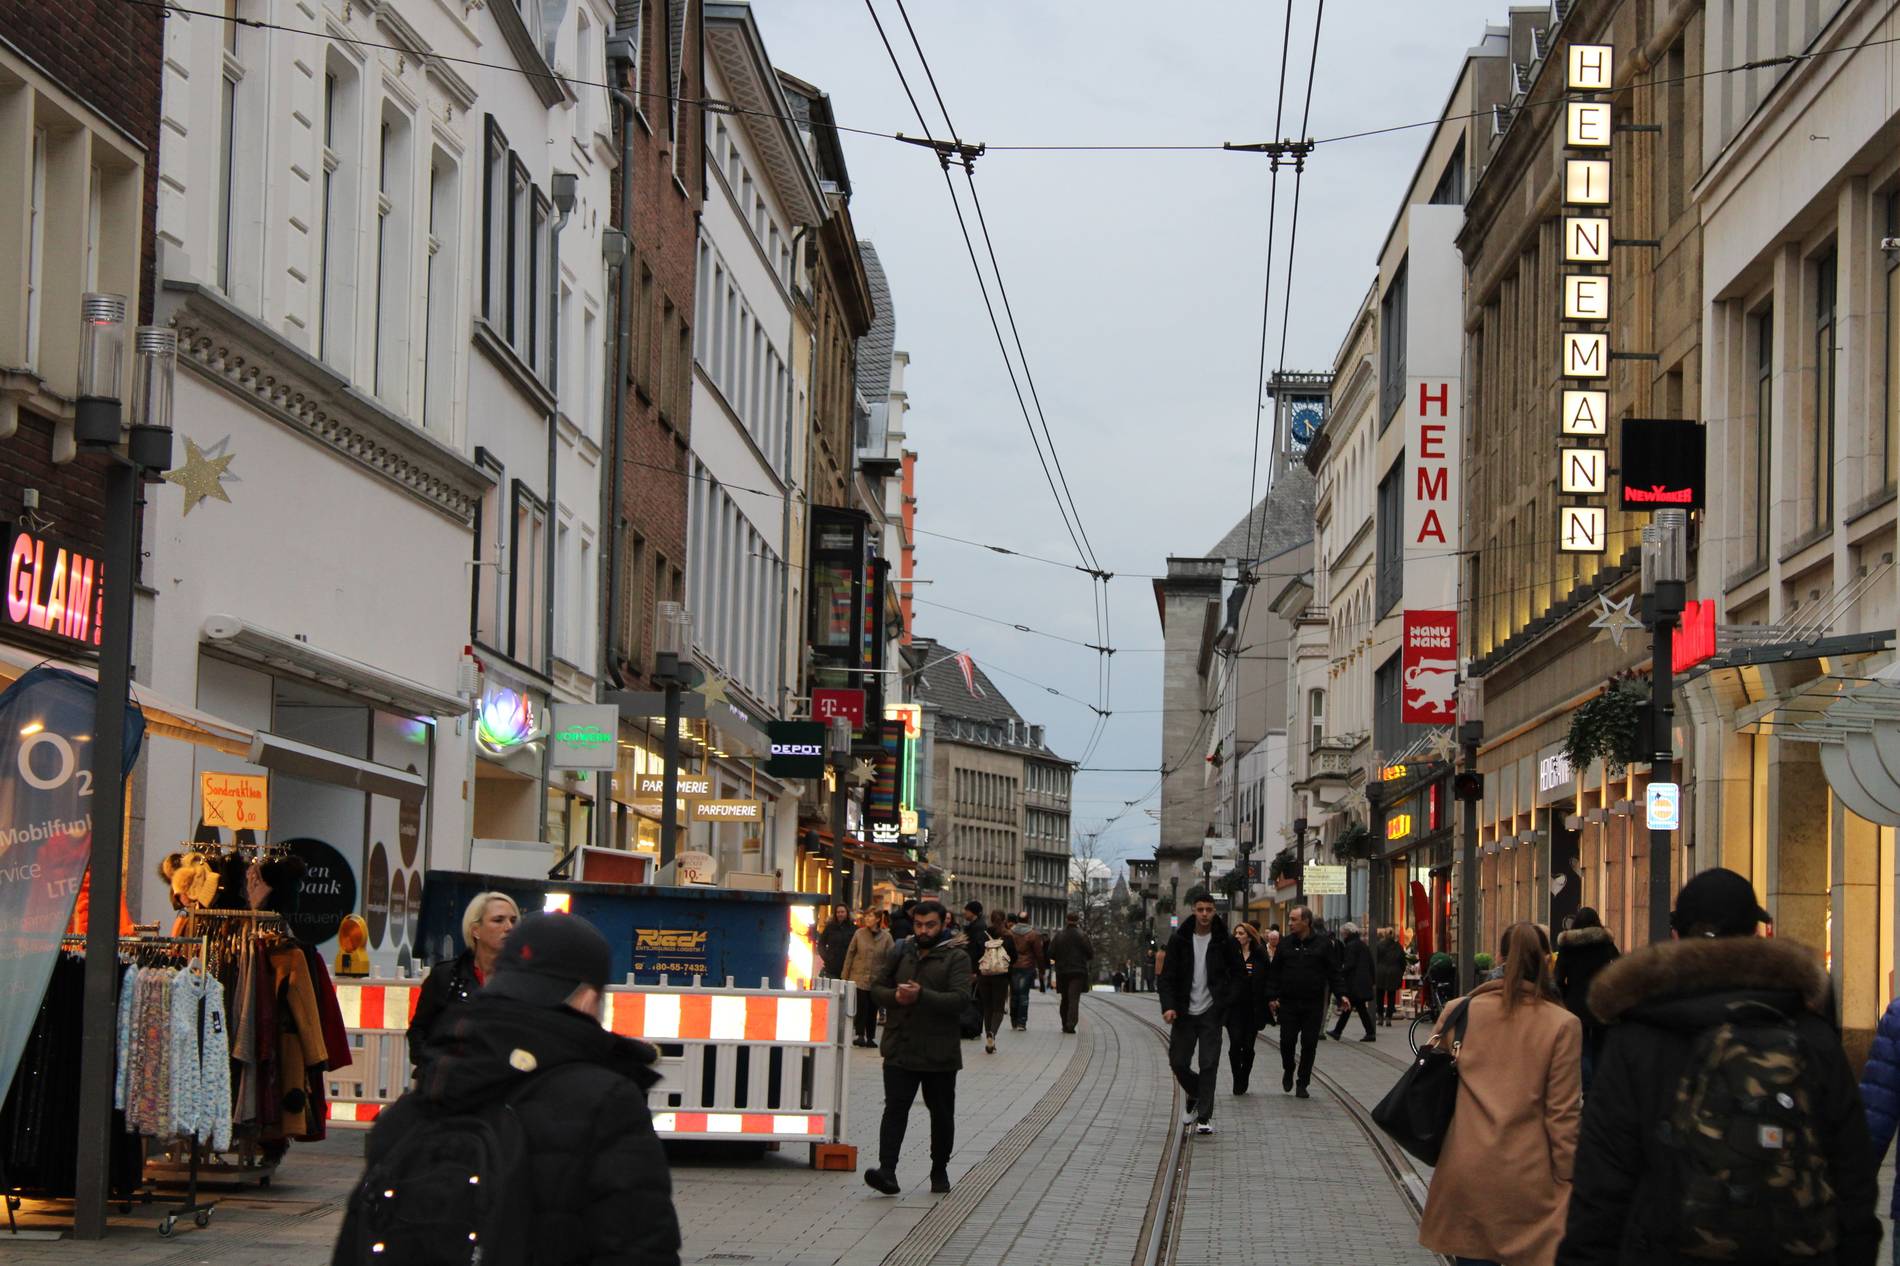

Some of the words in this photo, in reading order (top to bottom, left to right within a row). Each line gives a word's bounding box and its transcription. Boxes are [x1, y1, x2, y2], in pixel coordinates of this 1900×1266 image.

[1571, 50, 1603, 545] HEINEMANN
[1416, 385, 1449, 544] HEMA
[8, 532, 95, 642] GLAM
[771, 744, 822, 755] DEPOT
[641, 780, 709, 794] PARMERIE
[0, 862, 42, 885] rvice
[47, 876, 79, 899] LTE
